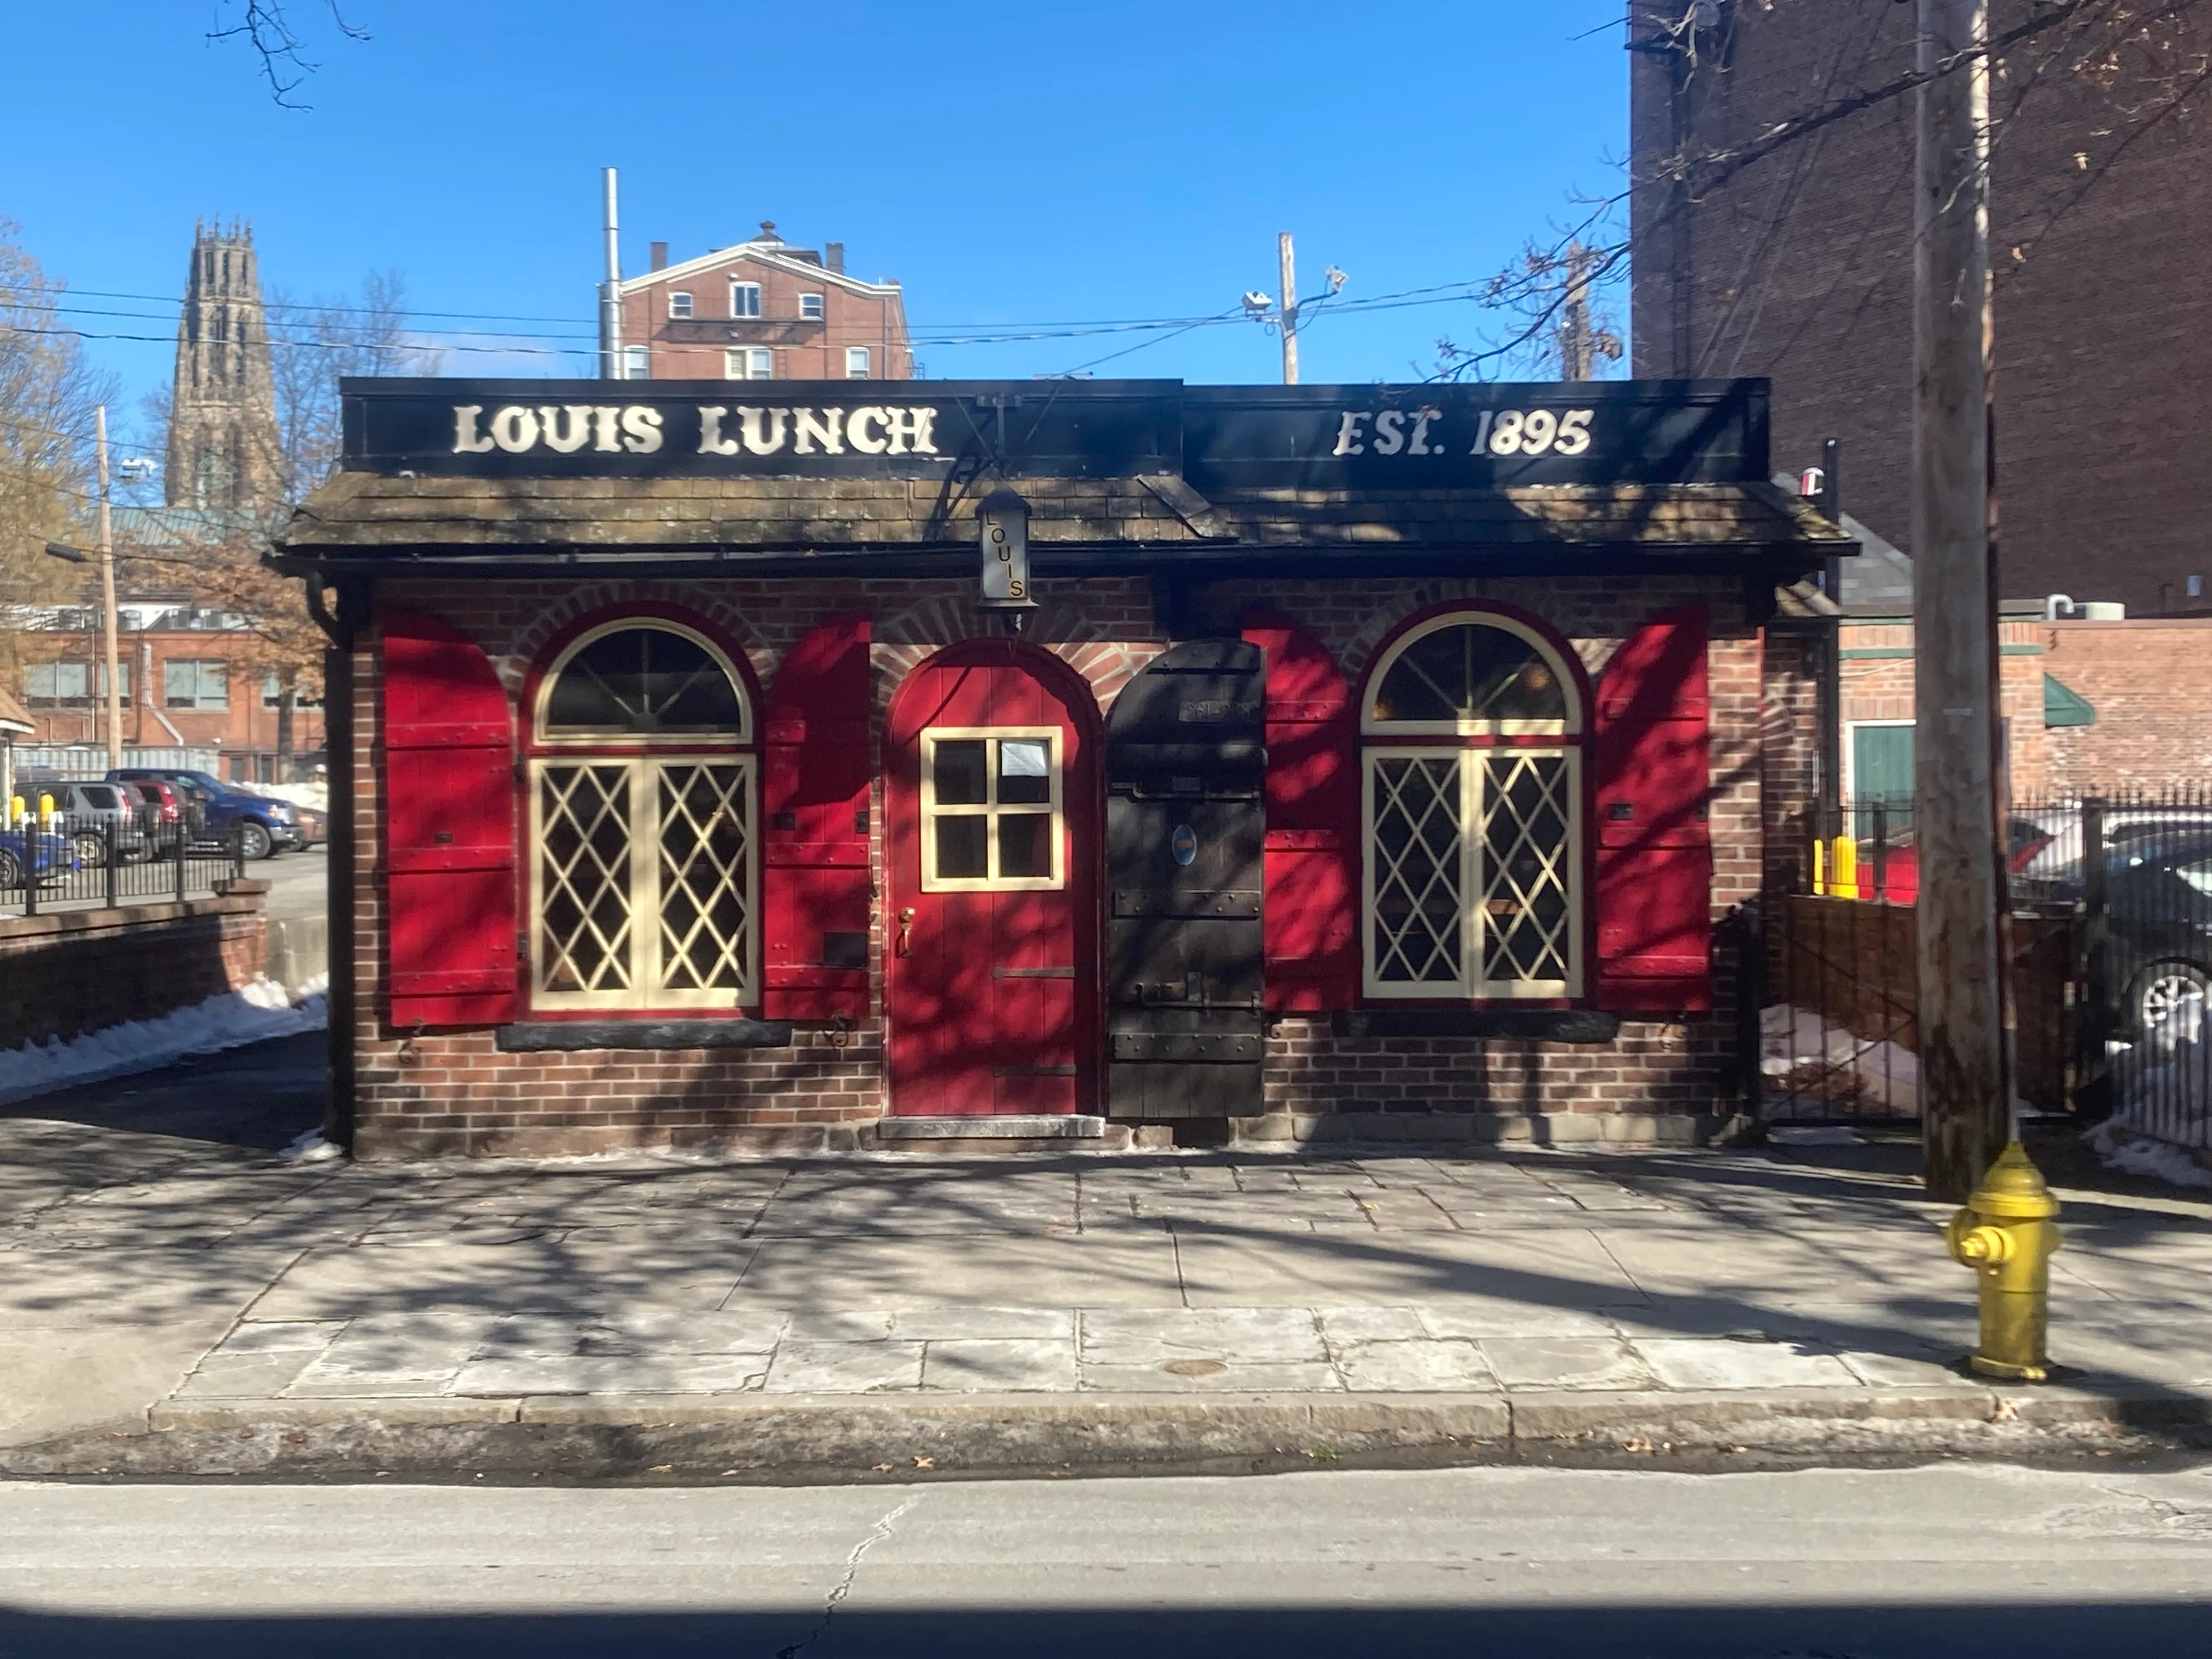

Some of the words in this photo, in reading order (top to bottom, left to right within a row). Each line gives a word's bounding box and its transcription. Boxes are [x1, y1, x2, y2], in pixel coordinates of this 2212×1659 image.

[452, 405, 664, 454] LOUIS
[696, 405, 938, 455] LUNCH
[1332, 409, 1445, 456] EST.
[1469, 409, 1595, 455] 1895
[986, 511, 1023, 596] LOUIS
